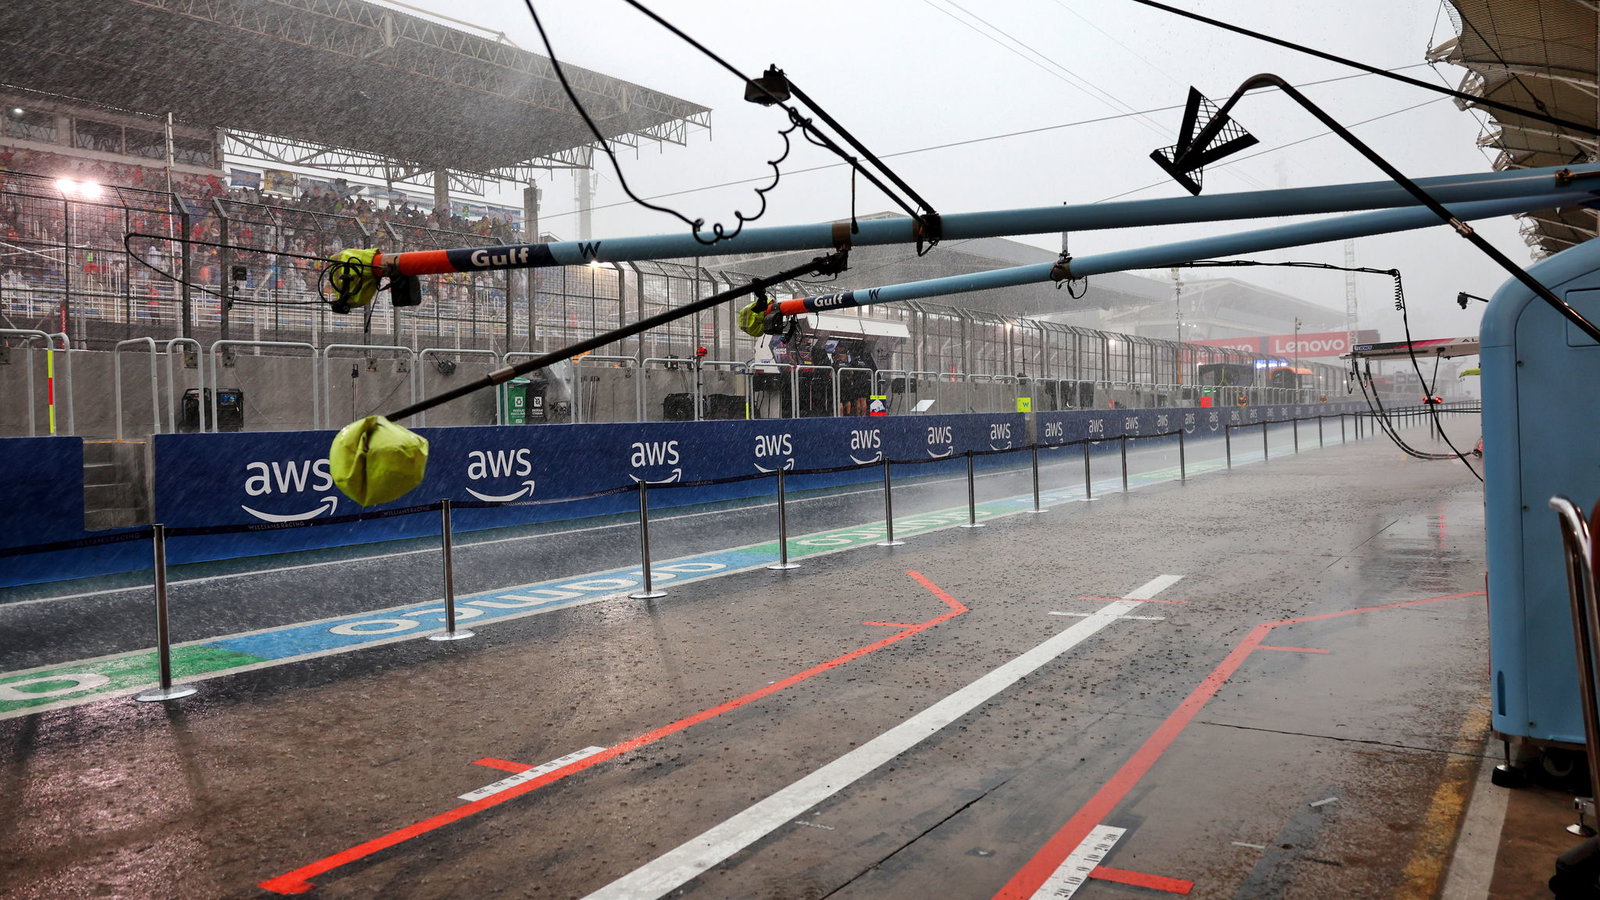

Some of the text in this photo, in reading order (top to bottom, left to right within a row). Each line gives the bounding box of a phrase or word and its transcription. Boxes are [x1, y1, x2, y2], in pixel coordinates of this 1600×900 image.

[471, 247, 530, 267] Gulf
[814, 293, 844, 307] Gulf
[1276, 339, 1345, 354] Lenovo
[1045, 422, 1063, 437] aws
[1088, 419, 1104, 433] aws
[1125, 416, 1139, 430] aws
[1157, 414, 1168, 427] aws
[850, 429, 881, 450] aws
[928, 426, 953, 445] aws
[990, 423, 1011, 440] aws
[631, 441, 680, 467] aws
[755, 434, 793, 457] aws
[467, 449, 532, 480] aws
[245, 459, 333, 496] aws
